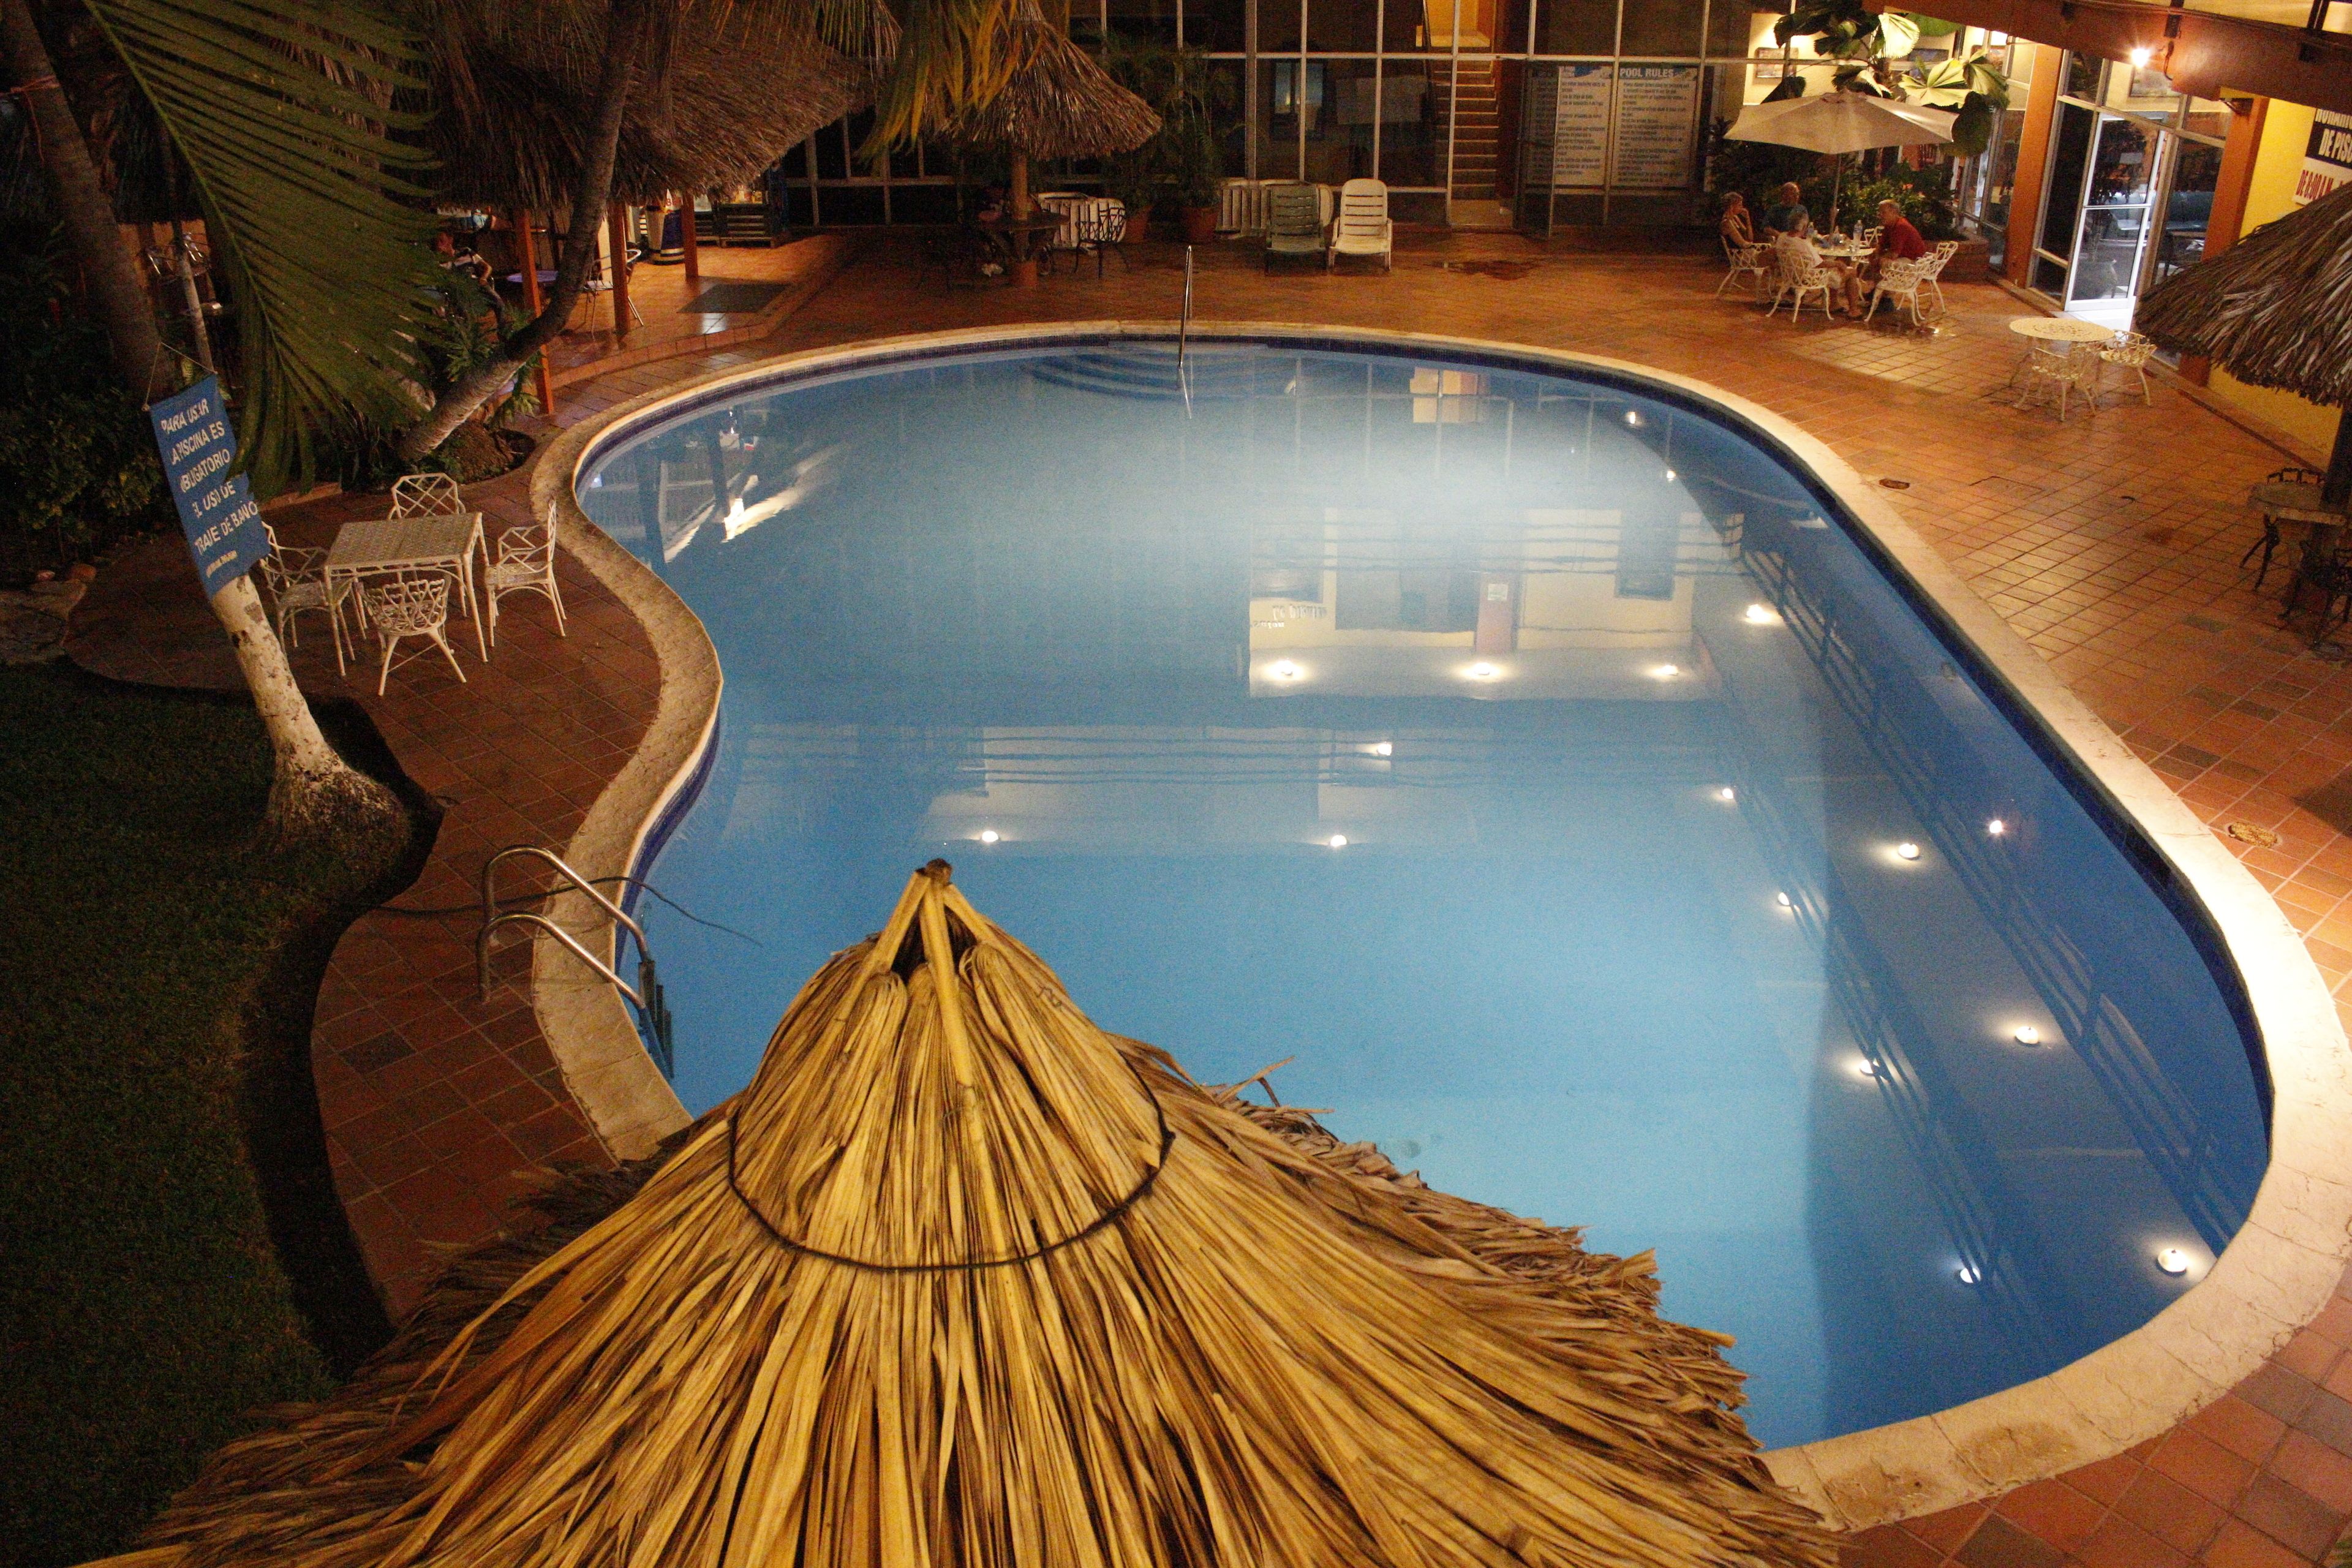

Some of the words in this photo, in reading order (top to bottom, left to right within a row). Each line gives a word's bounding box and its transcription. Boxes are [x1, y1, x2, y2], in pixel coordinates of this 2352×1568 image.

[1619, 68, 1643, 77] POOL
[1645, 68, 1674, 78] RULES
[2318, 128, 2335, 157] DE
[2296, 169, 2309, 196] DE
[160, 412, 187, 434] PARA
[208, 421, 225, 439] ES
[220, 480, 236, 499] DE
[220, 517, 234, 536] DE
